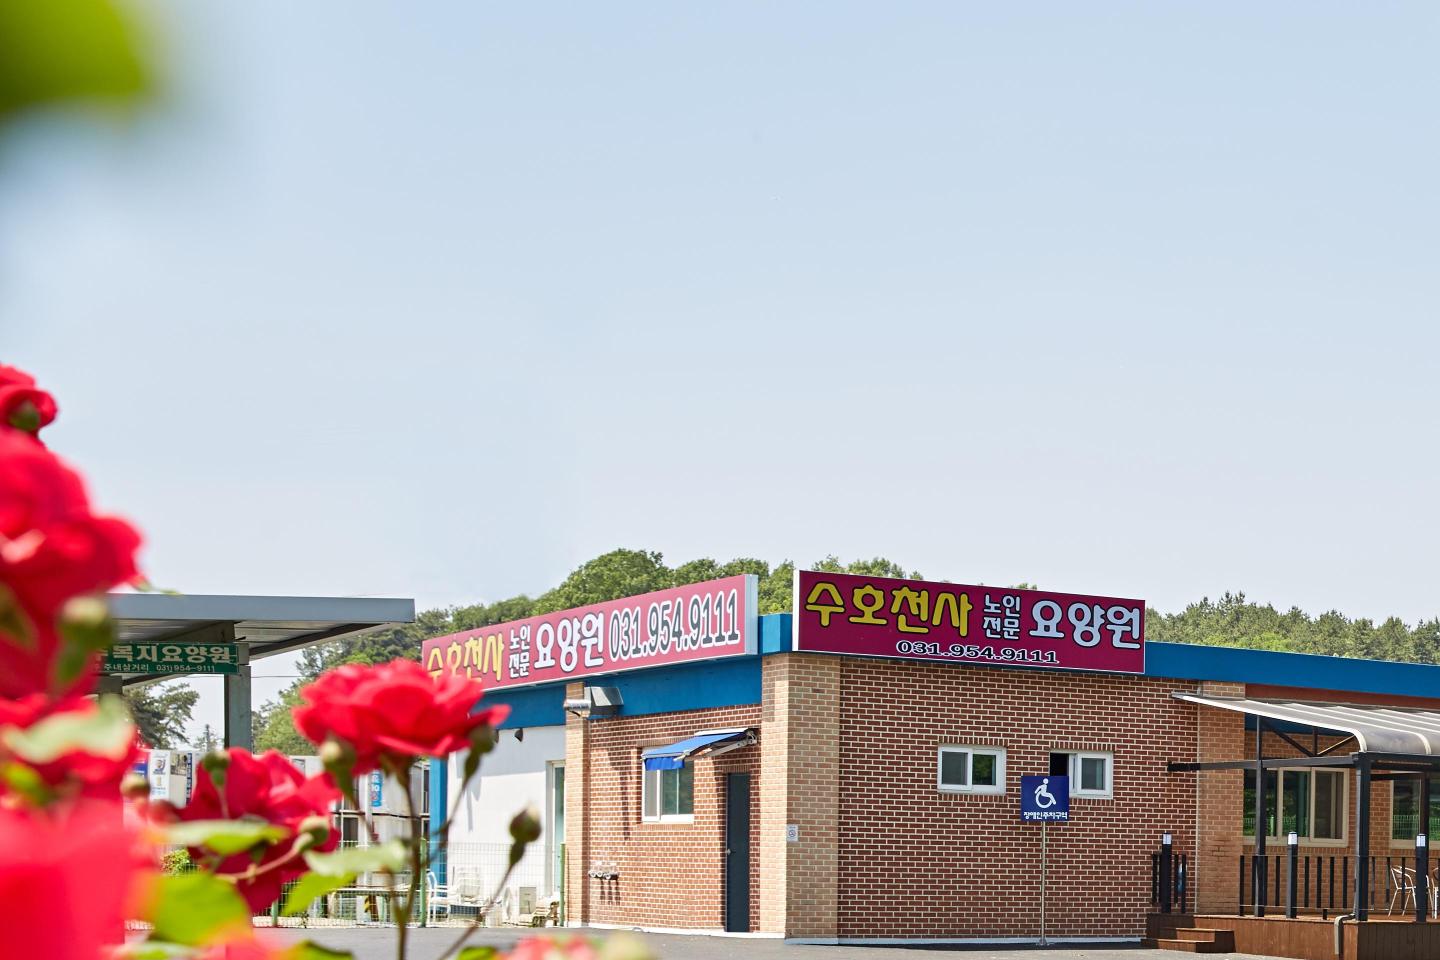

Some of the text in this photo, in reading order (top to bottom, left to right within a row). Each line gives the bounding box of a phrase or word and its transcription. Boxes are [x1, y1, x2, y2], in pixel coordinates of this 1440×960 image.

[608, 588, 740, 662] 031.954.9111
[805, 582, 1141, 650] 수호천사 노인 전문 요양원
[509, 625, 531, 650] 노인
[534, 612, 604, 673] 요양원
[96, 644, 230, 664] 복지요양원
[509, 651, 530, 678] 전문
[896, 640, 1060, 664] 031.954.9111
[1023, 811, 1068, 820] 장애인주차구역
